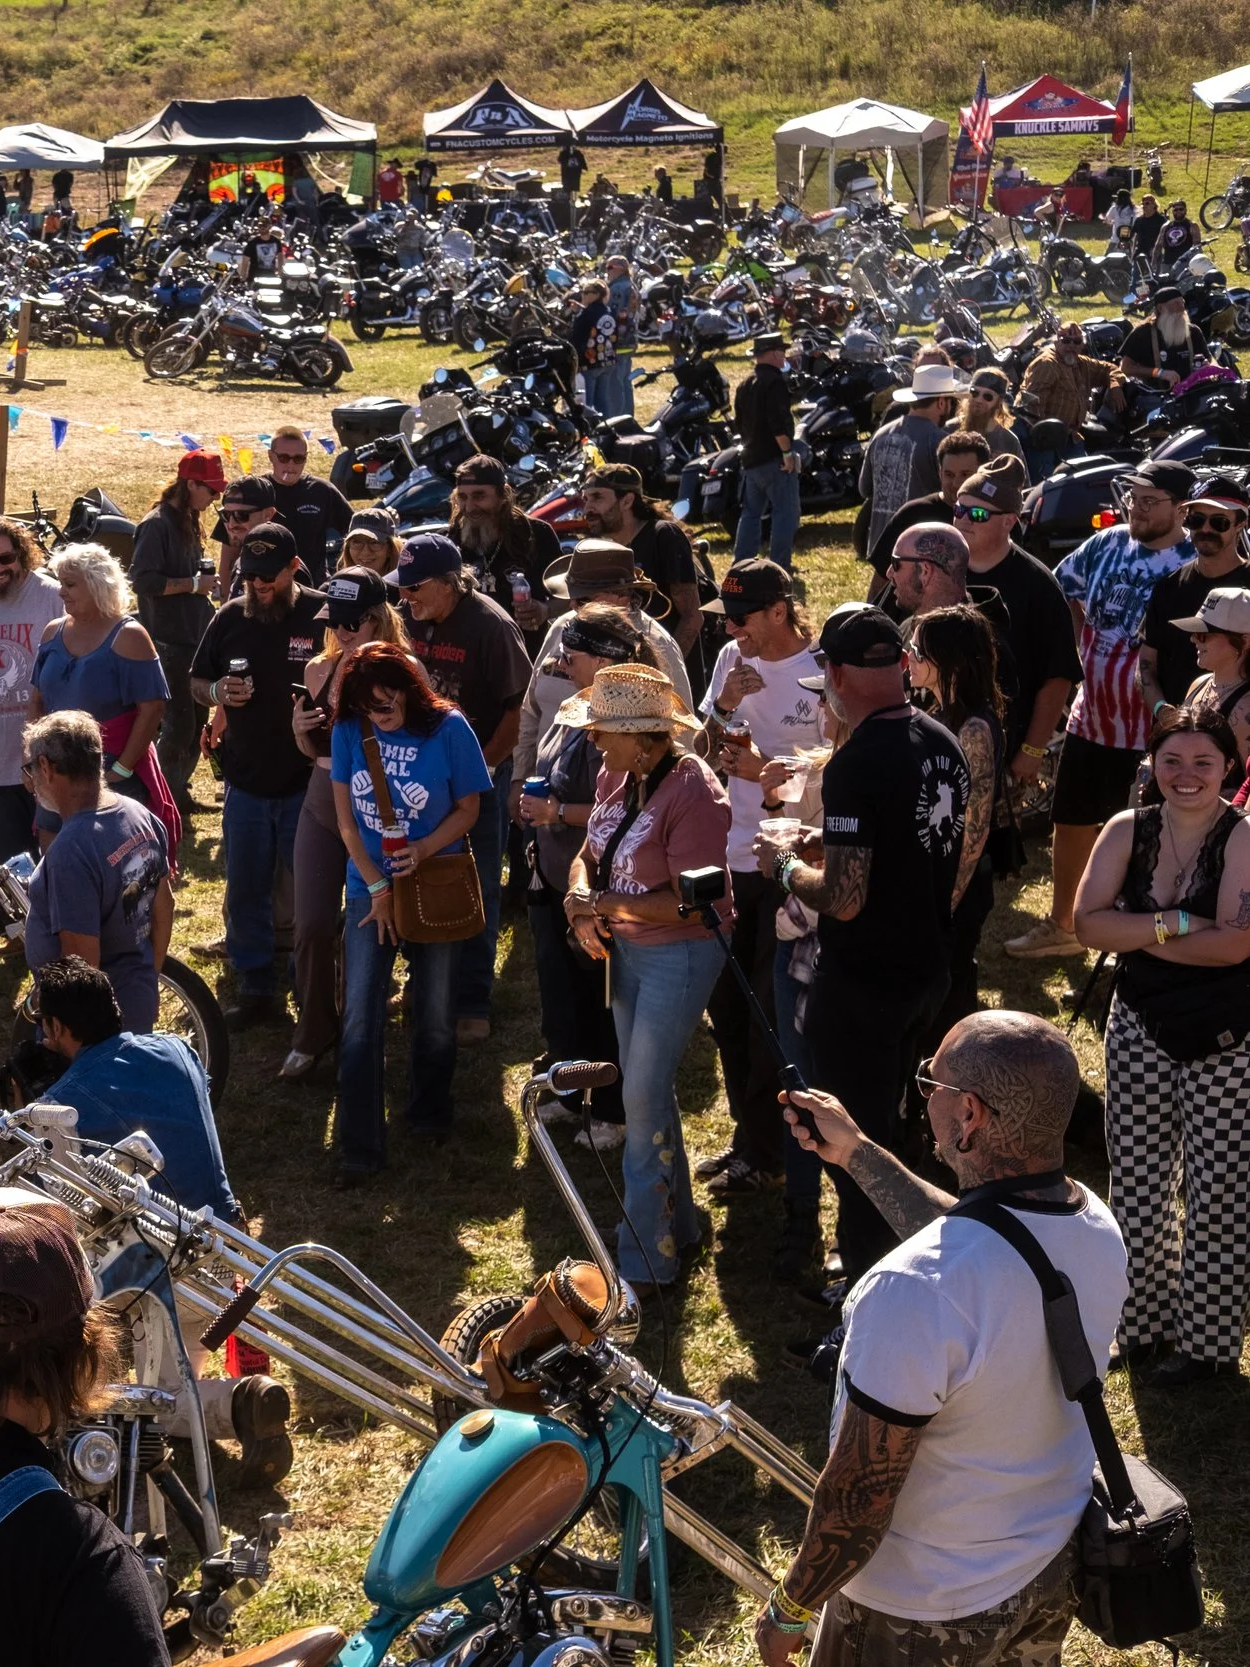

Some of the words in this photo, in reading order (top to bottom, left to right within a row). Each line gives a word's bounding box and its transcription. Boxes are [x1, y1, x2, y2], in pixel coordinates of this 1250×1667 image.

[1014, 121, 1058, 135] KNUCKLE
[1058, 120, 1099, 133] SAMMYS
[445, 136, 556, 148] FNACUSTOMCYCLES.COM
[586, 134, 632, 143] Motorcycle
[635, 134, 673, 144] Magneto
[675, 132, 714, 142] Ignitions
[16, 689, 29, 702] 13
[376, 740, 418, 762] THIS
[381, 758, 410, 777] AL
[935, 755, 950, 770] YOU
[408, 807, 420, 820] A
[363, 813, 410, 836] BER
[826, 816, 858, 833] FREEDOM
